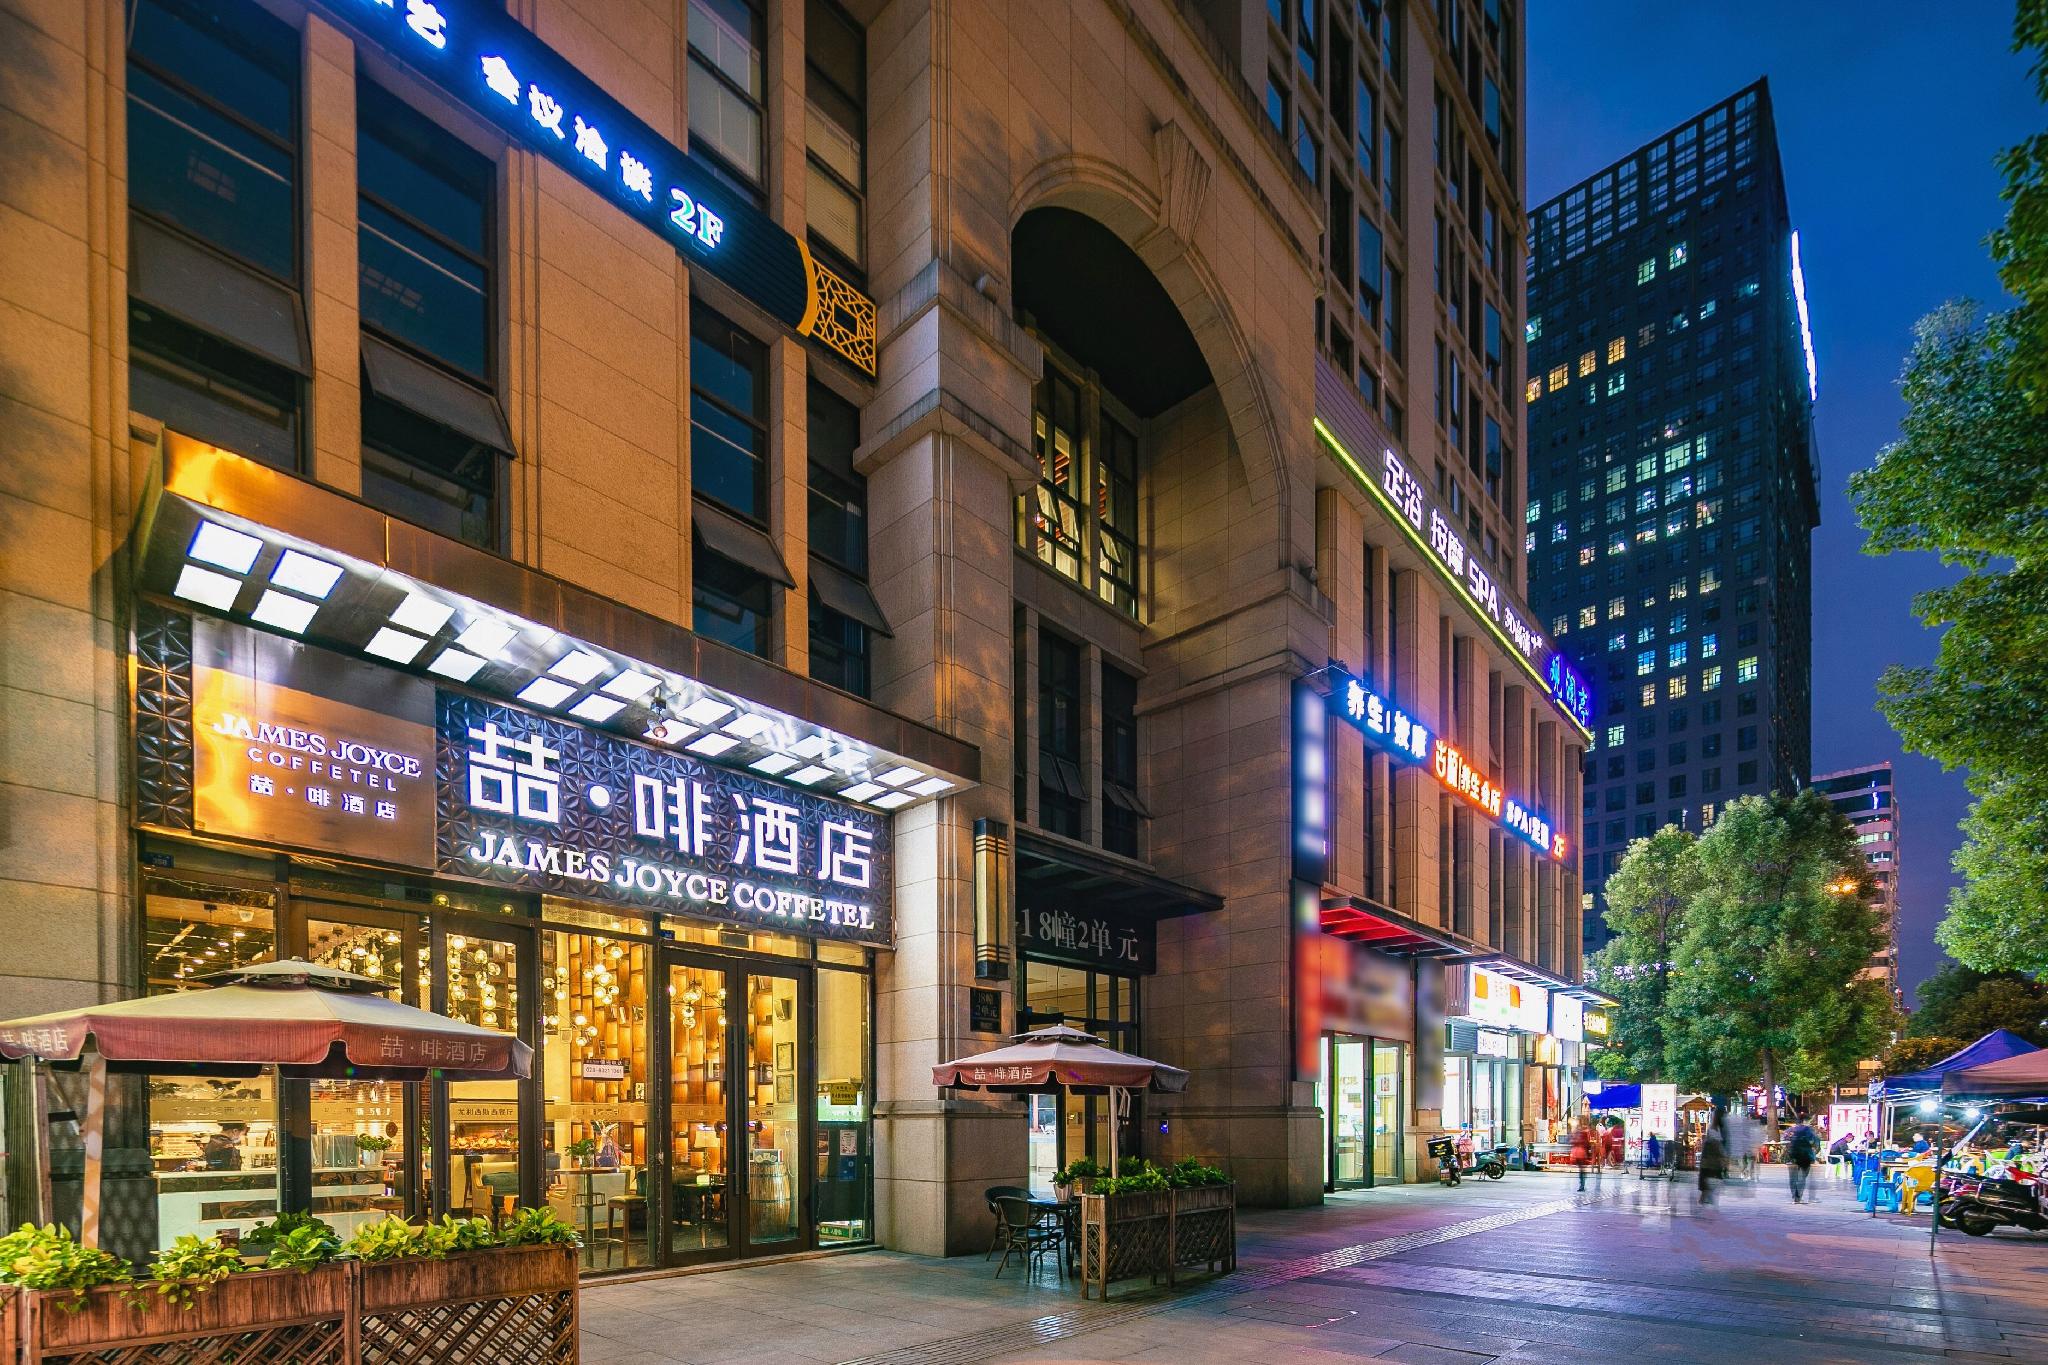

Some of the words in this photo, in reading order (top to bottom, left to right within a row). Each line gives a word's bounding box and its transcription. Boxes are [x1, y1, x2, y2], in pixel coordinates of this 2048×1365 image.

[670, 188, 724, 248] 2F
[1383, 449, 1423, 531] 足浴
[1468, 558, 1499, 621] SPA
[213, 712, 327, 757] JAMES
[330, 739, 422, 779] JOYCE
[248, 747, 398, 792] COFFETEL
[470, 831, 611, 883] JAMES
[616, 857, 729, 906] JOYCE
[732, 885, 875, 930] COFFETEL
